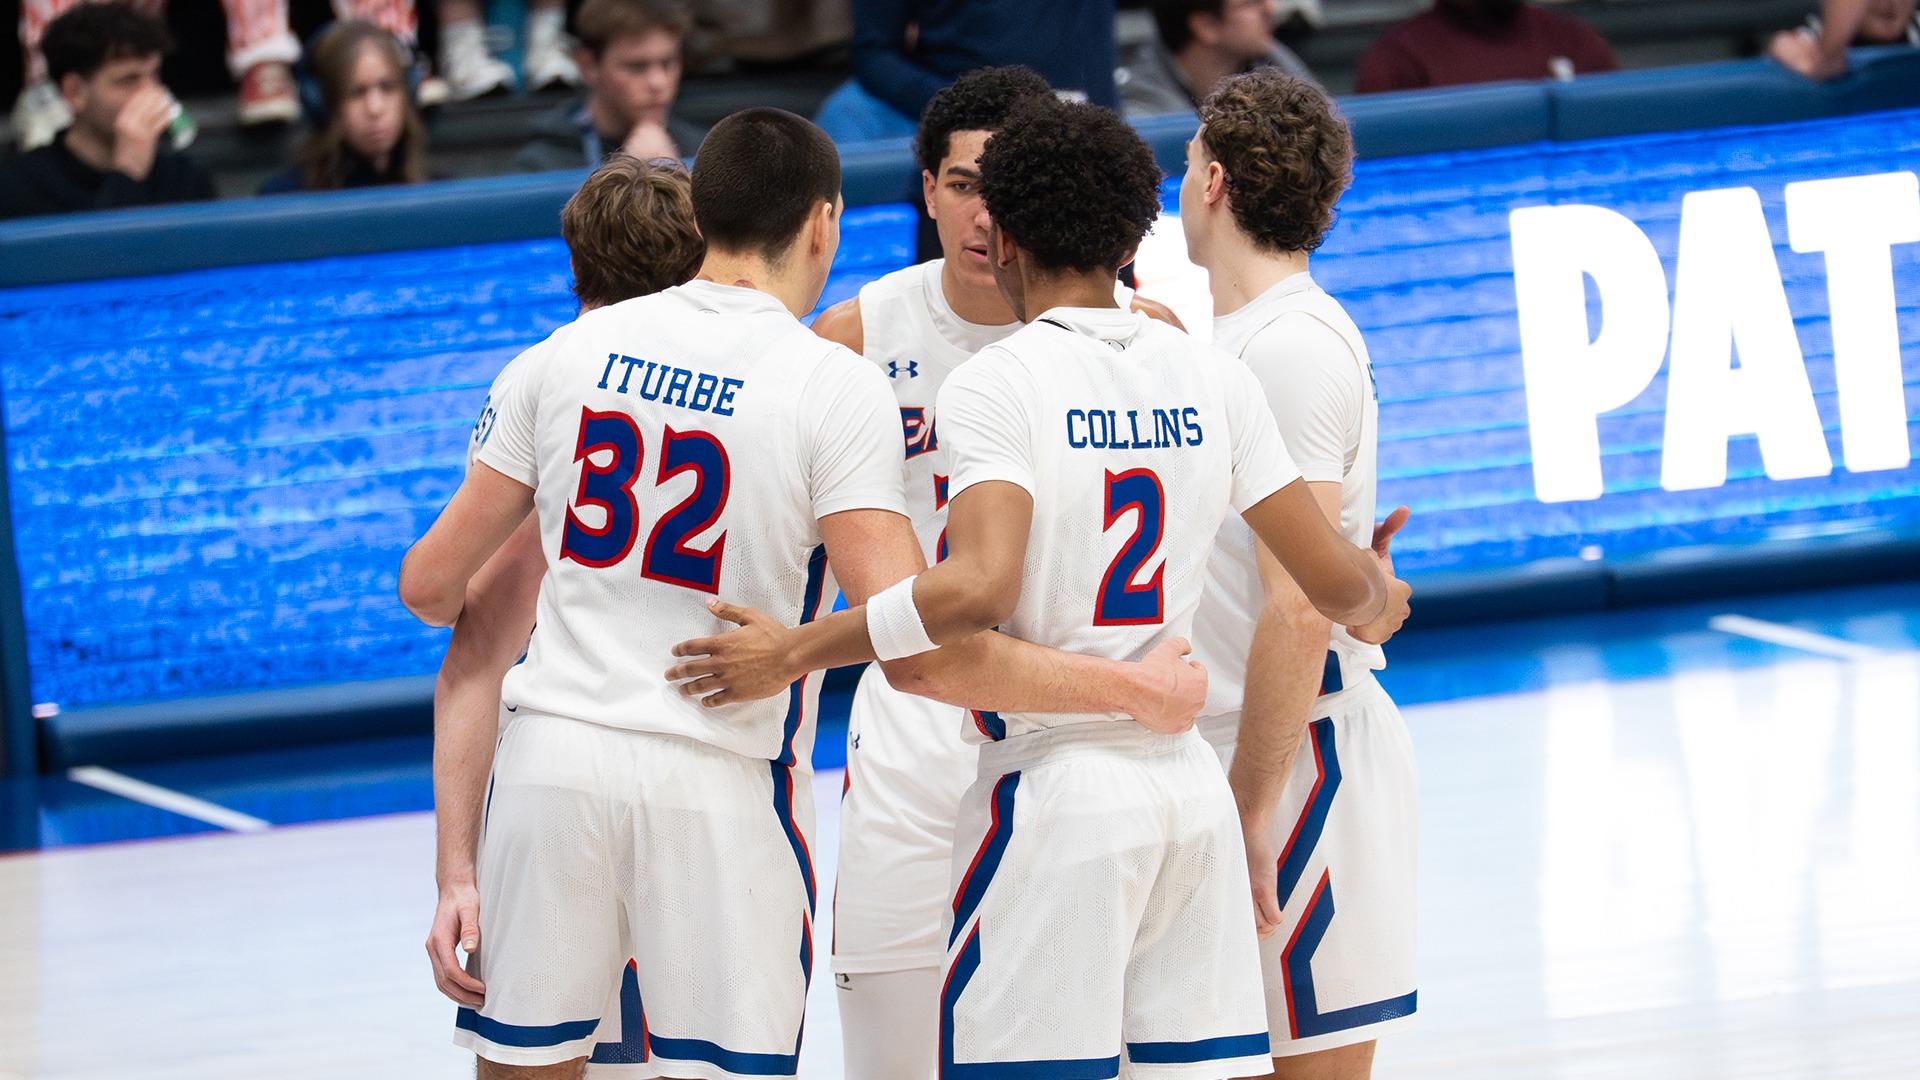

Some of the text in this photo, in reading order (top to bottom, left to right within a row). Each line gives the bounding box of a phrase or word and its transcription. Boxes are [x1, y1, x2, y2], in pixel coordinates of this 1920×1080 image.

[597, 353, 744, 416] ITURBE
[1509, 171, 1920, 503] PAT
[559, 405, 731, 595] 32
[1066, 407, 1203, 449] COLLINS
[1093, 467, 1167, 626] 2
